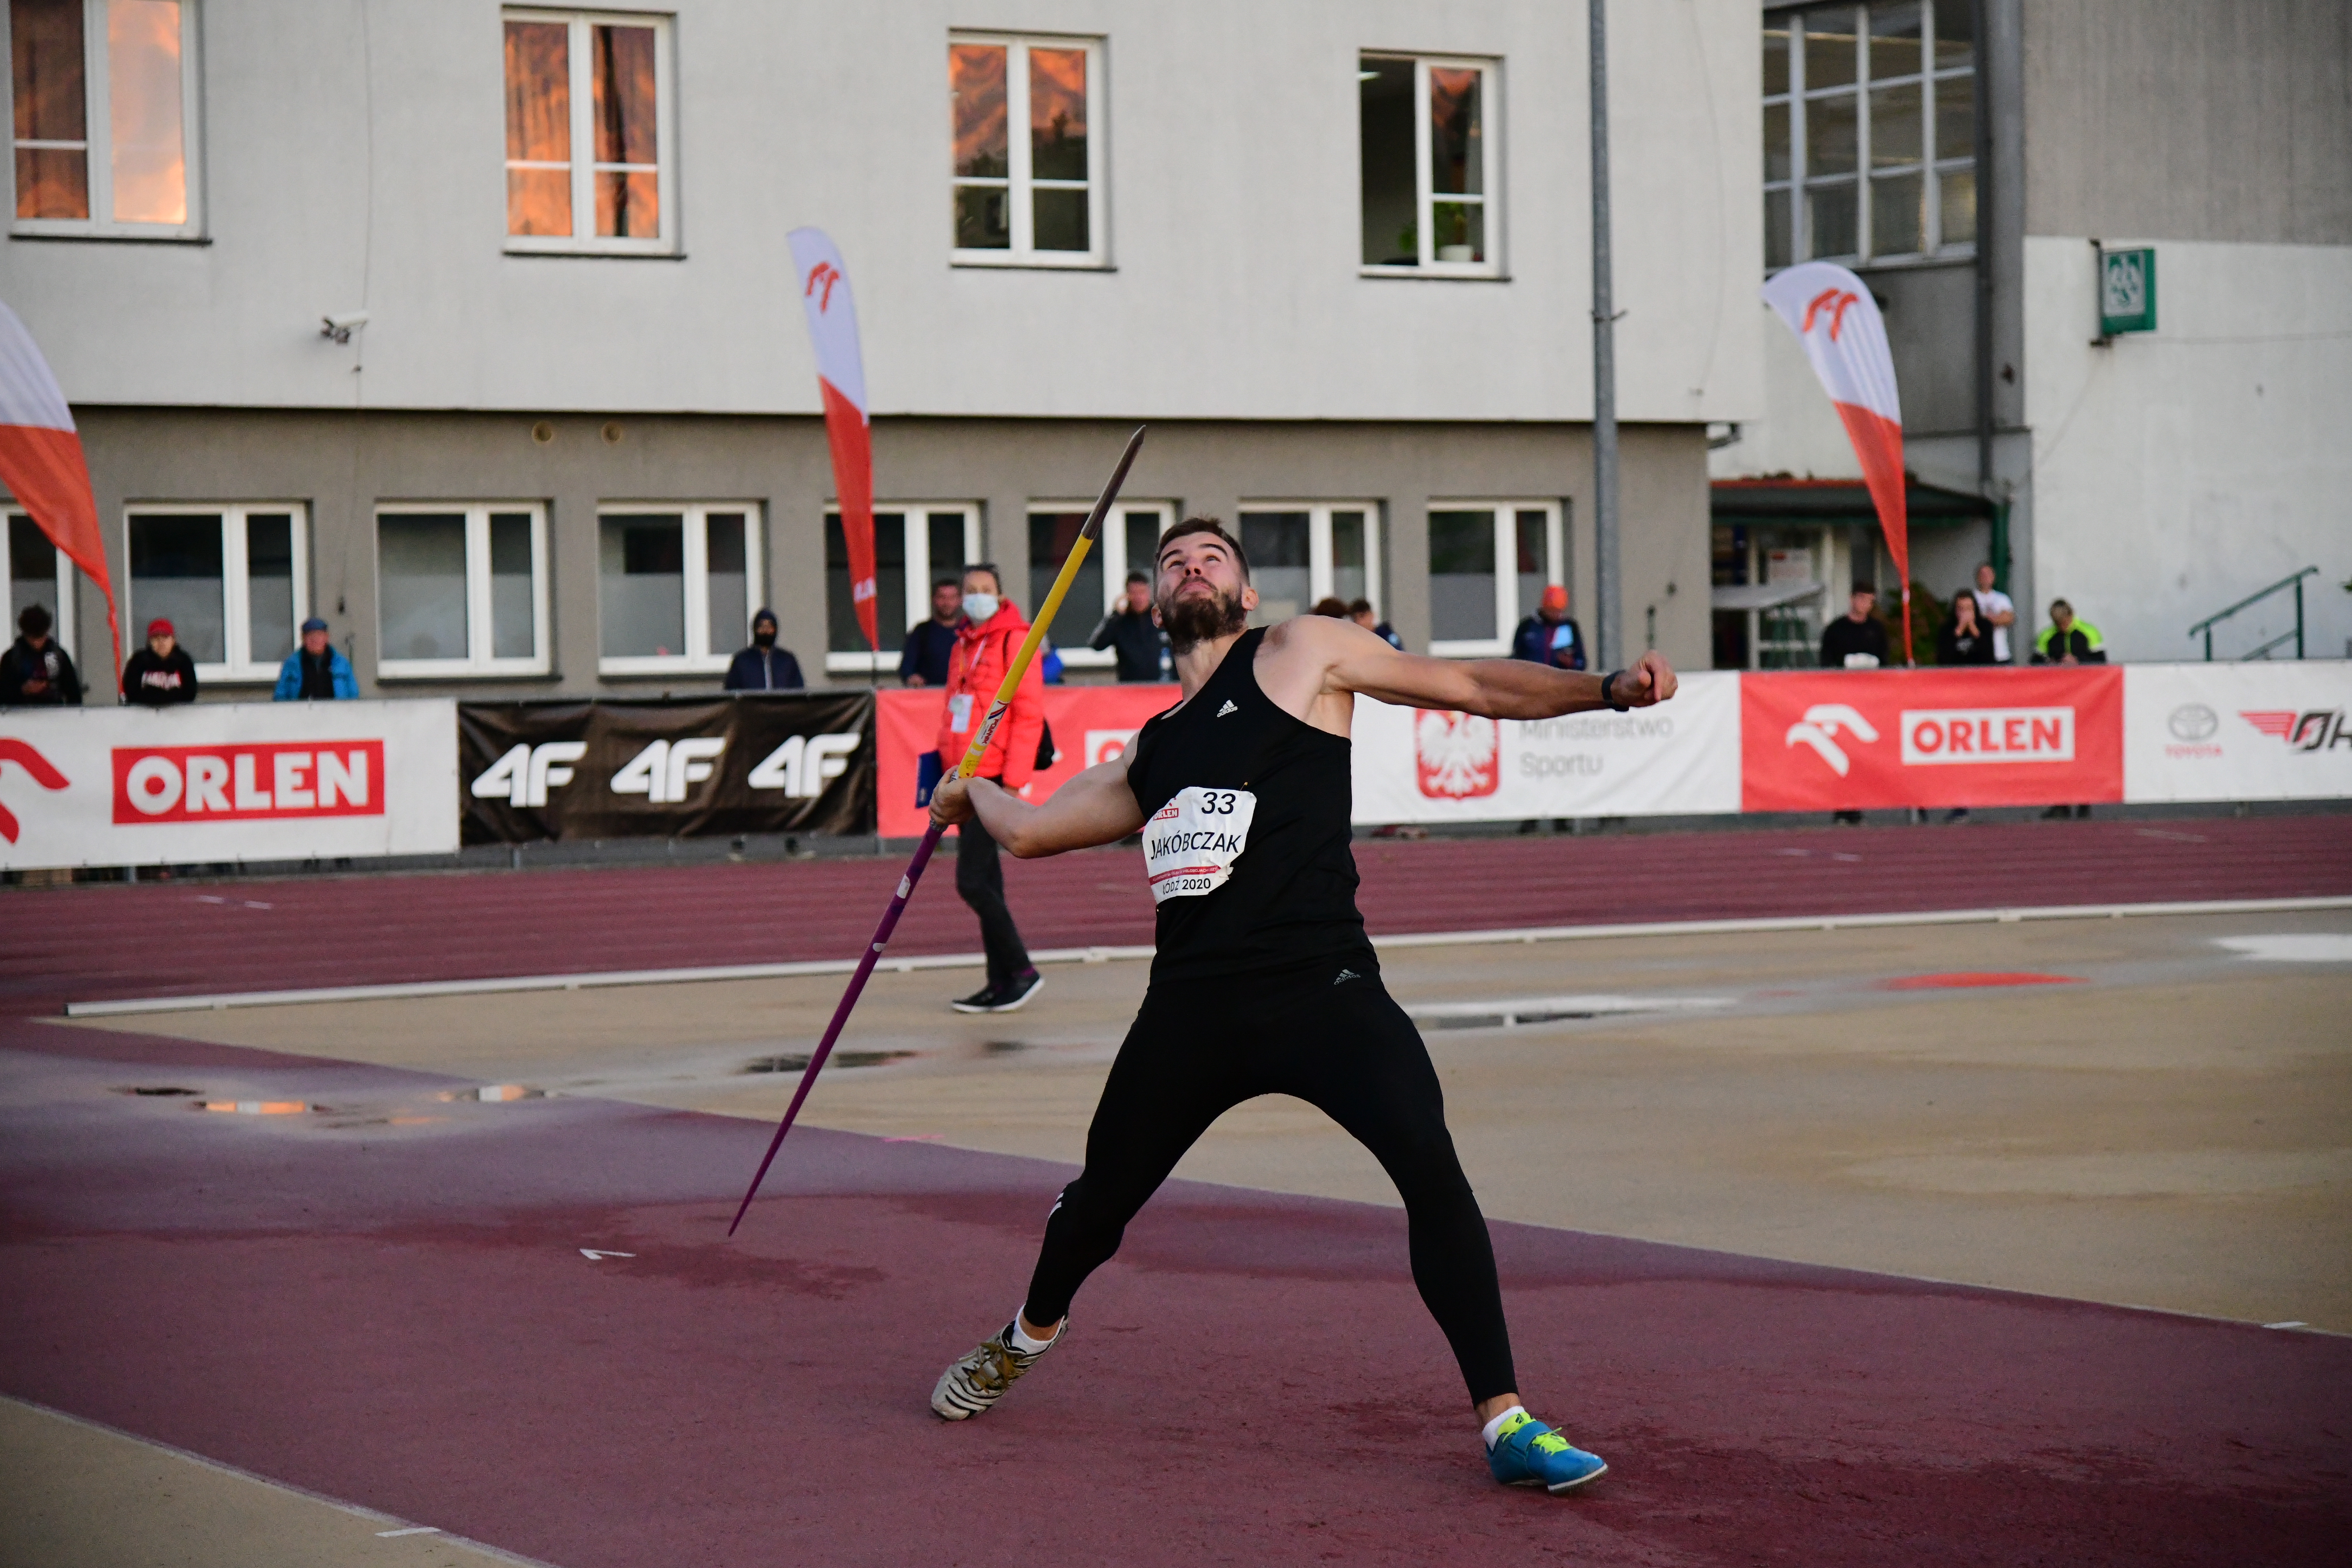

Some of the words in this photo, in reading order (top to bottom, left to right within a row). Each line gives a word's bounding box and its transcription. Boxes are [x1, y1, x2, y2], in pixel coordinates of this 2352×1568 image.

[1217, 706, 1238, 717] adidas
[1519, 716, 1674, 739] Ministerstwo
[1912, 718, 2061, 753] ORLEN
[2165, 744, 2223, 758] TOYOTA
[471, 741, 587, 807] 4F
[610, 737, 726, 803] 4F
[748, 733, 861, 798] 4F
[1520, 751, 1604, 782] Sportu
[127, 750, 369, 815] ORLEN
[1154, 809, 1178, 819] ORLEN
[1201, 791, 1236, 815] 33
[1151, 830, 1242, 860] JAKÓBCZAK
[1182, 878, 1211, 889] 2020
[1334, 974, 1361, 985] adidas
